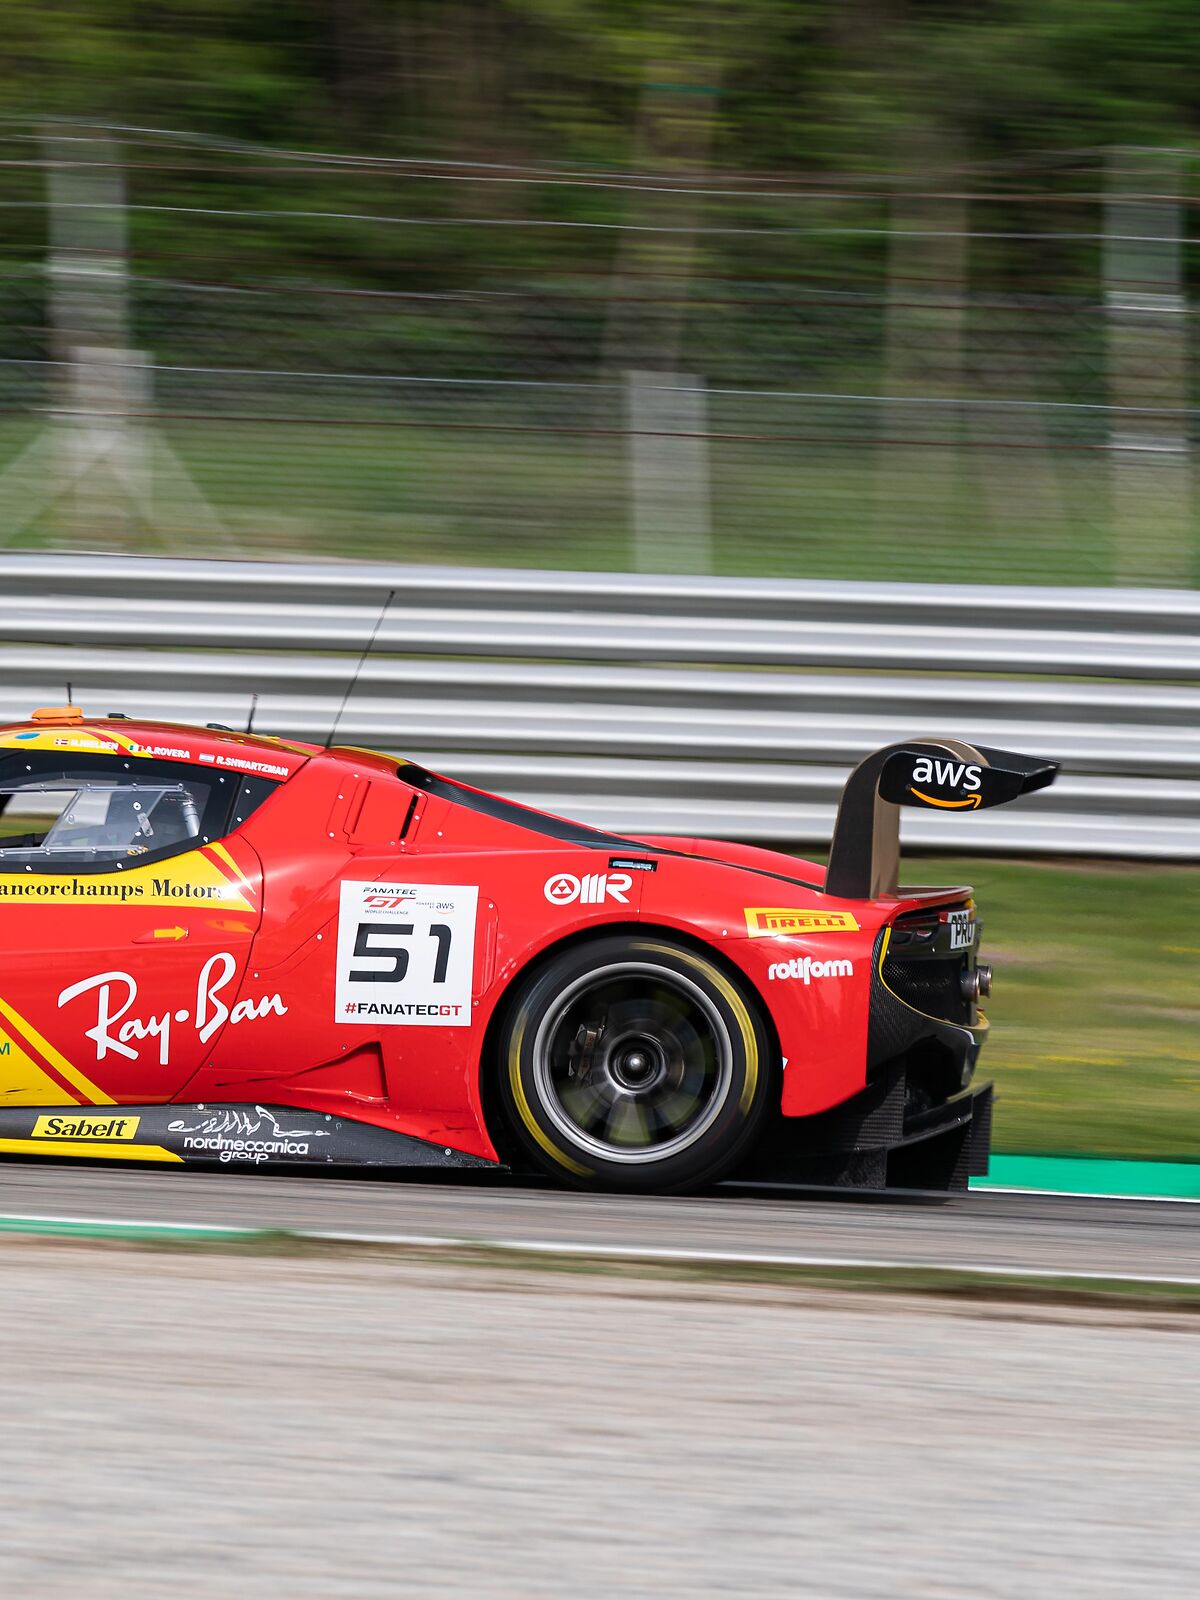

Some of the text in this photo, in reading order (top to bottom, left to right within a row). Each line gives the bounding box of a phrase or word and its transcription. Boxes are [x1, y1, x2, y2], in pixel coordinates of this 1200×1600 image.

[145, 746, 191, 759] A.ROVERA
[216, 755, 289, 777] R.SHWARTZMAN
[912, 757, 982, 791] aws
[362, 887, 417, 896] FANATEC
[362, 895, 417, 909] GT
[435, 902, 455, 910] aws
[756, 913, 846, 929] PIRELLI
[348, 922, 452, 983] 51
[768, 956, 854, 985] rotiform
[344, 1002, 463, 1017] #FANATECGT
[43, 1117, 130, 1138] Sabelt
[182, 1134, 309, 1155] nordmeccanica
[219, 1149, 269, 1165] group
